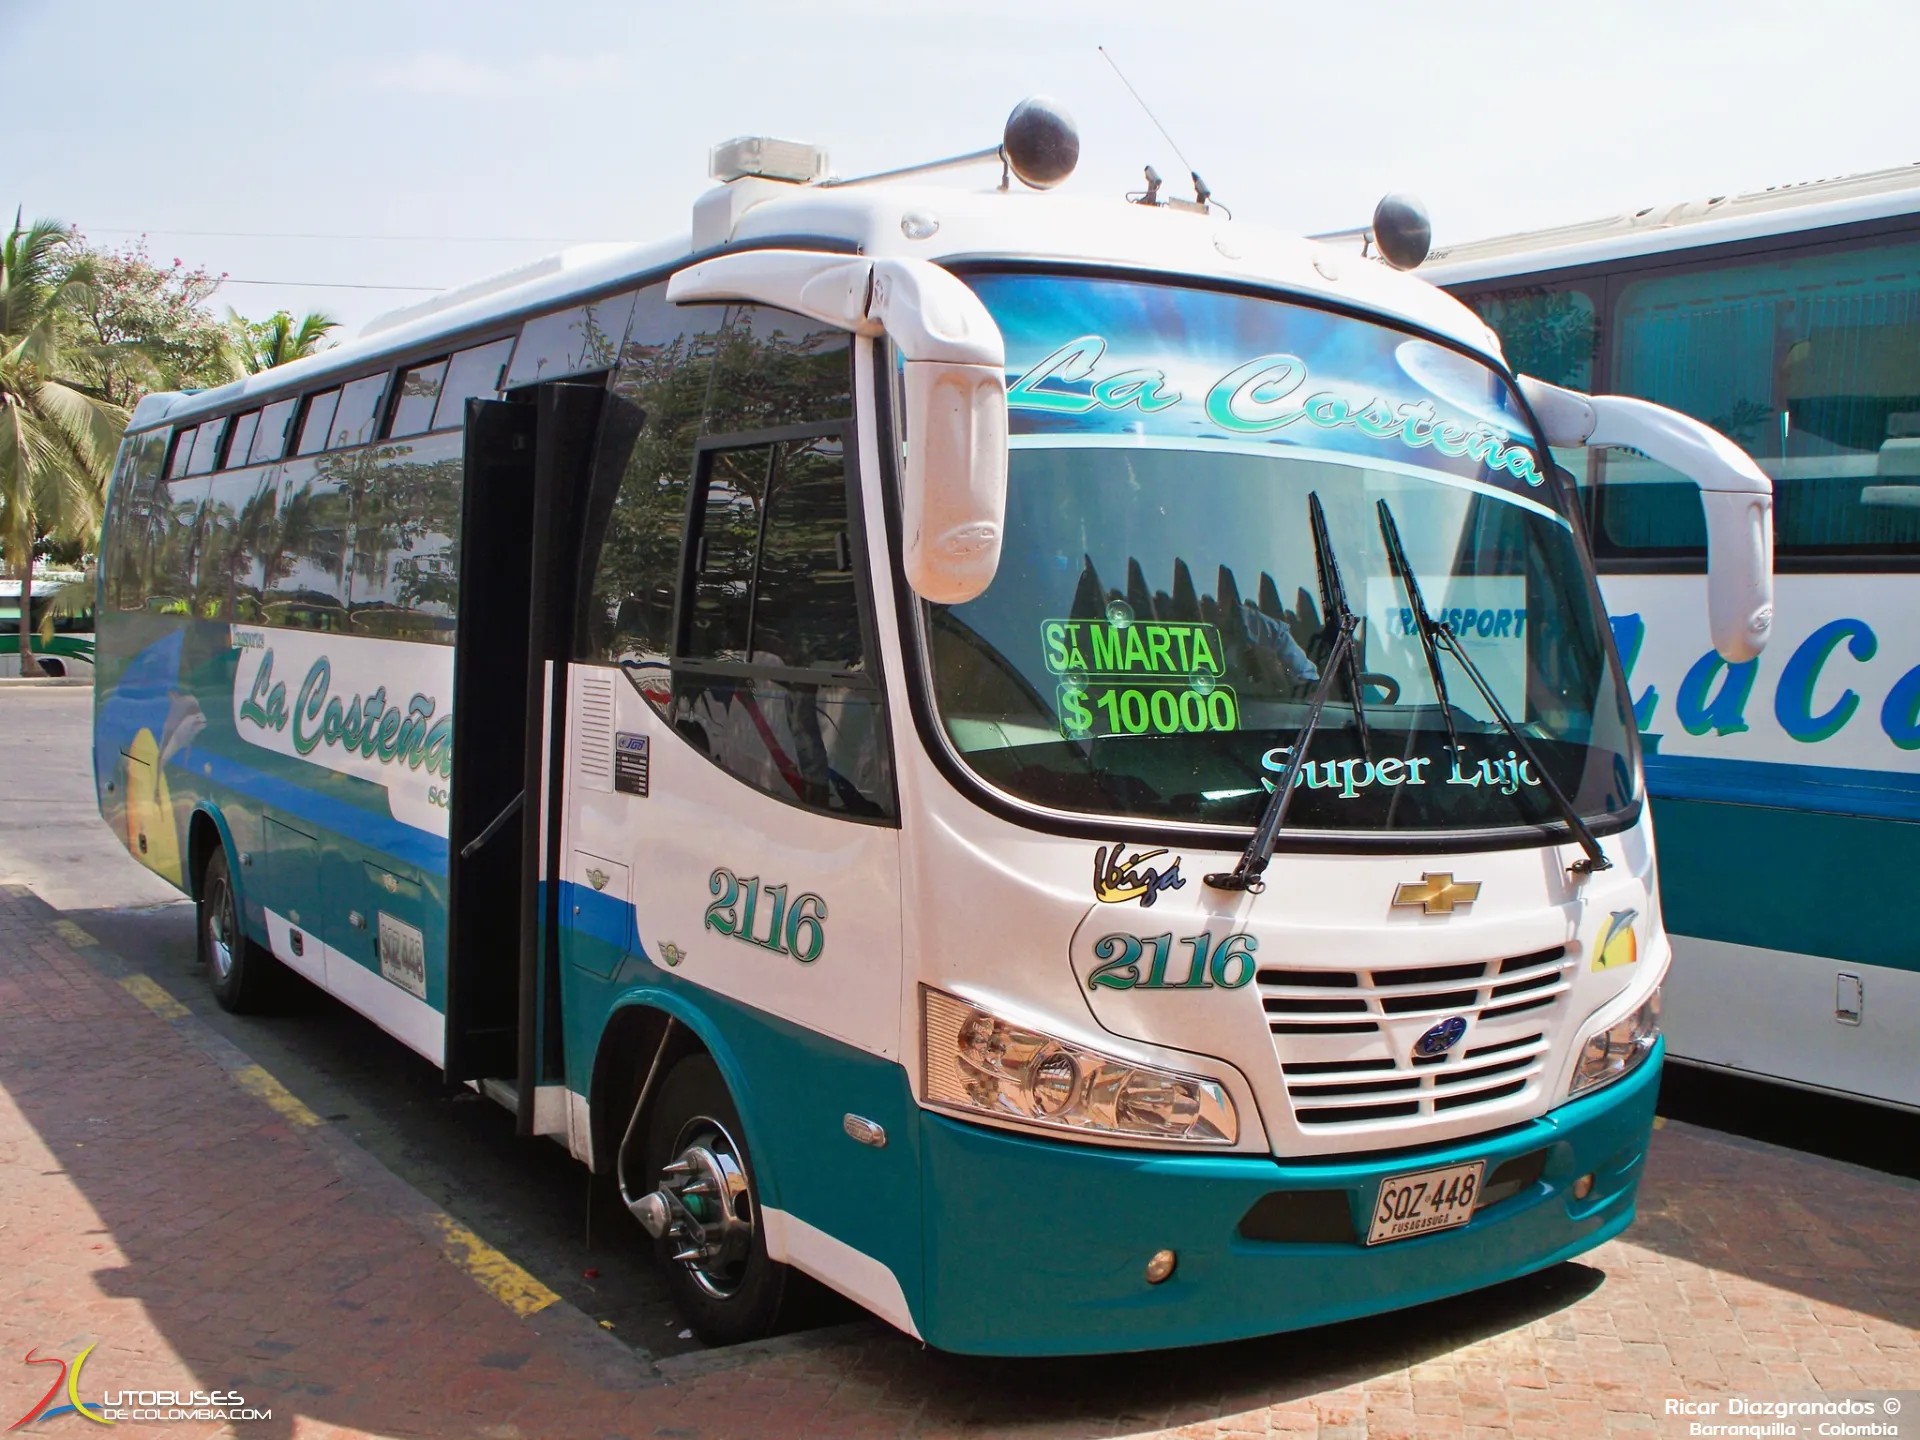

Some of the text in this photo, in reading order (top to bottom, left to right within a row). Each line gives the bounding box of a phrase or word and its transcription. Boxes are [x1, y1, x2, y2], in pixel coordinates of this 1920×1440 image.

[1007, 336, 1544, 487] La Costeña
[1090, 624, 1219, 673] MARTA
[240, 647, 453, 779] La Costeña
[1260, 745, 1431, 798] Super
[704, 866, 829, 964] 2116
[1087, 931, 1258, 991] 2116
[1391, 1213, 1450, 1234] FUSAGASUGA
